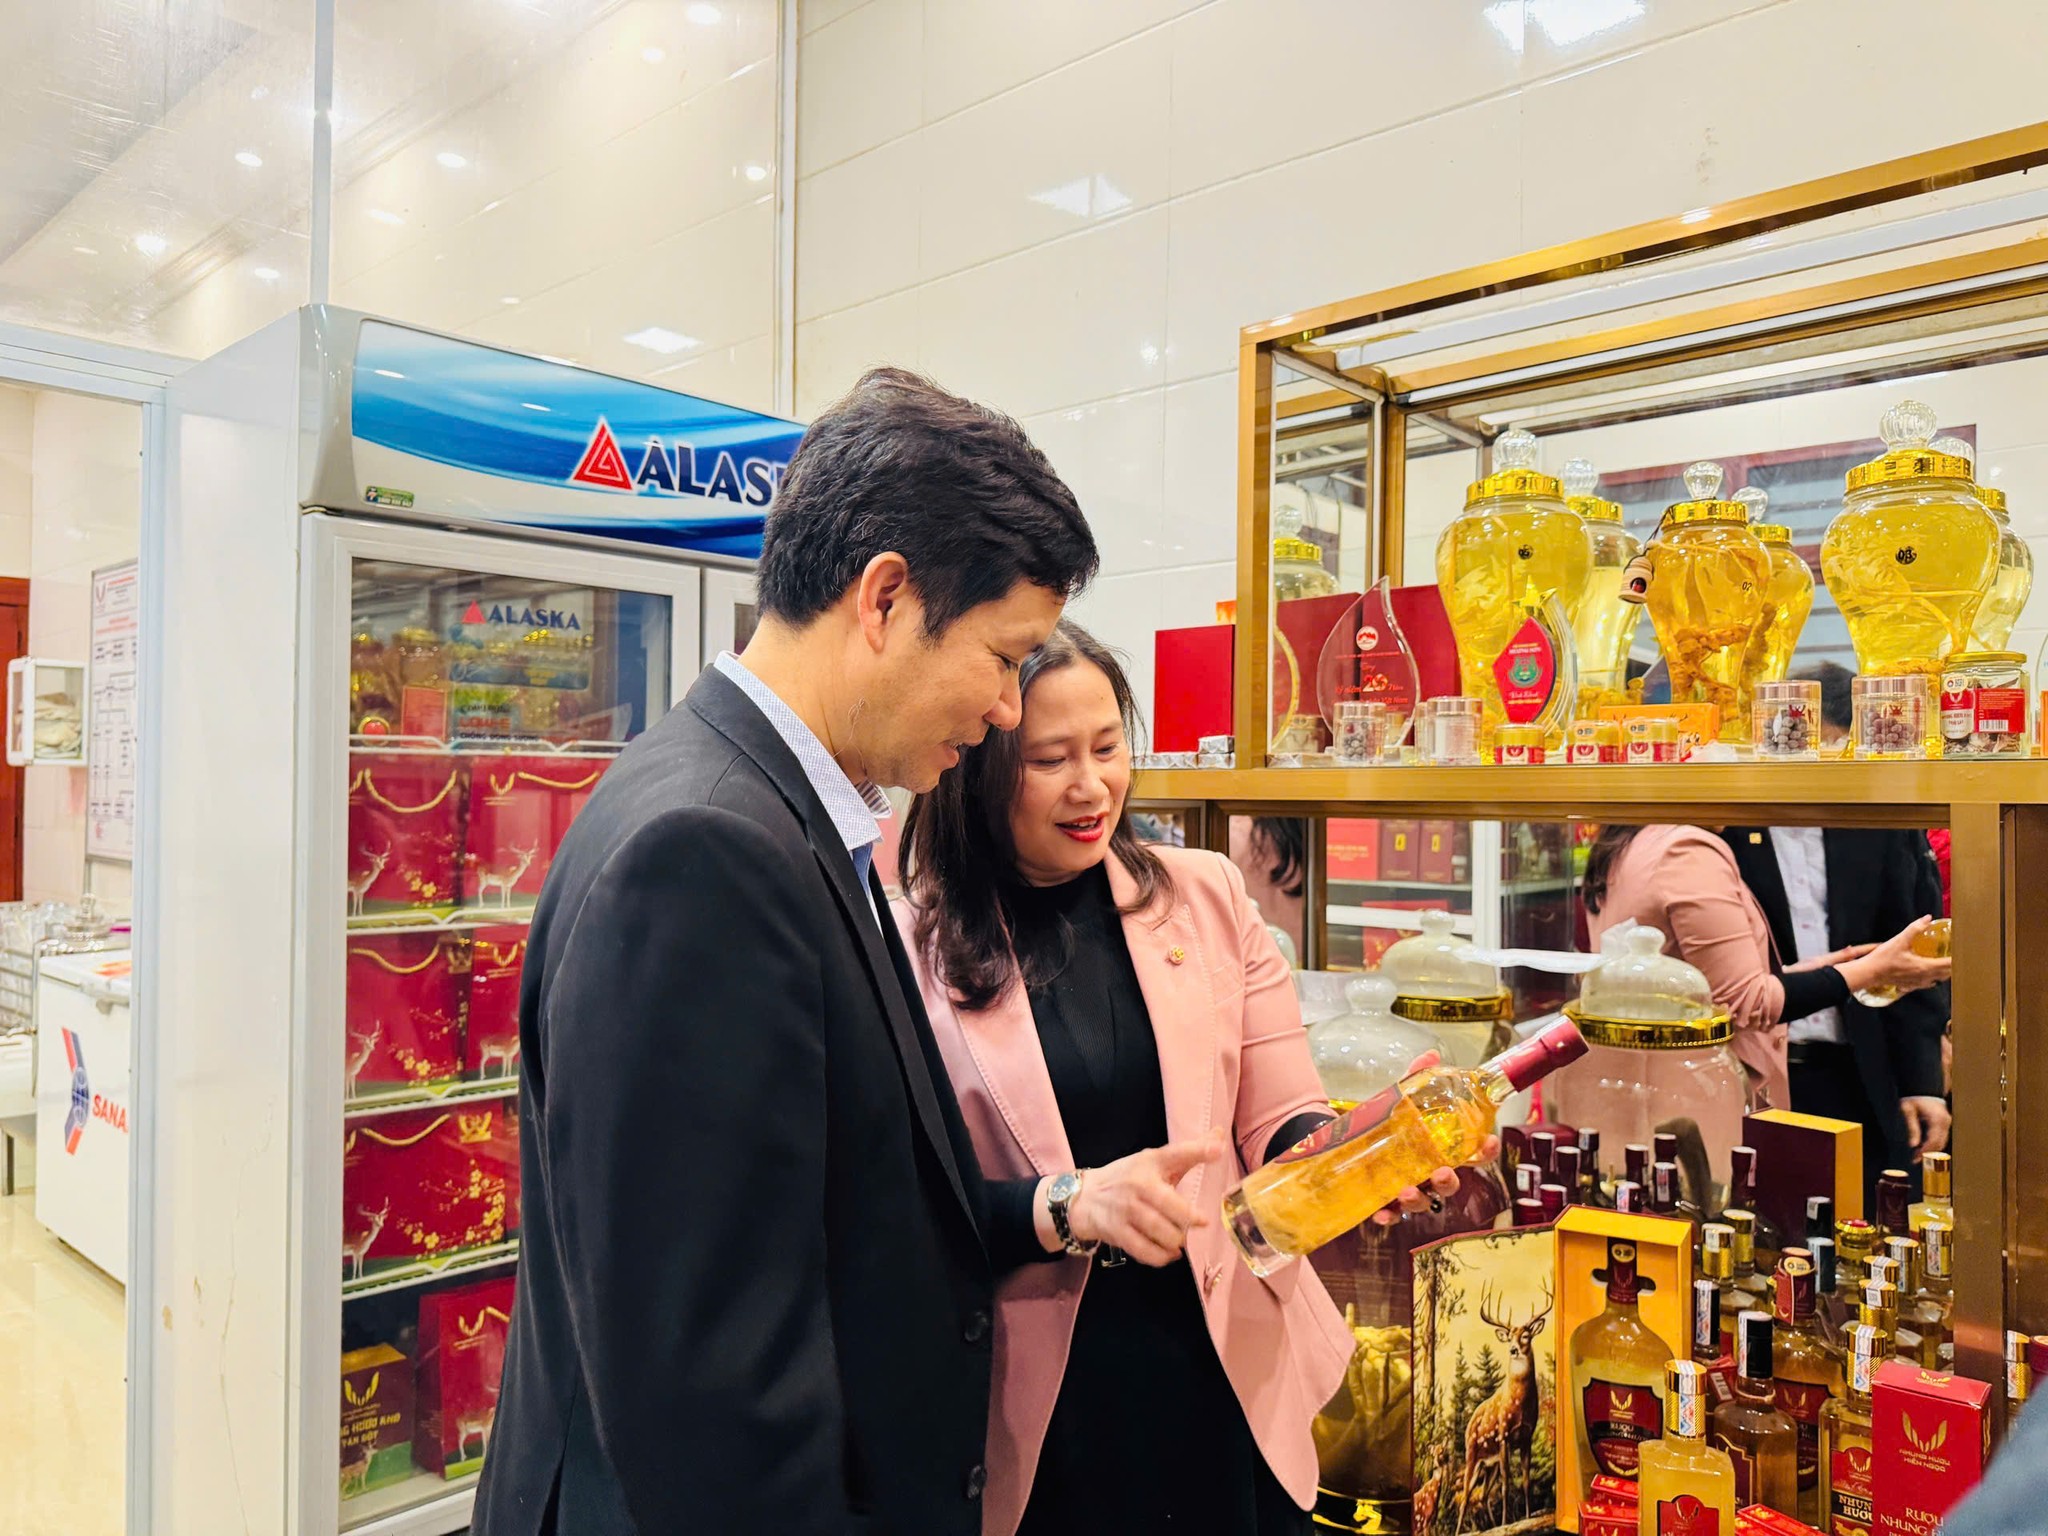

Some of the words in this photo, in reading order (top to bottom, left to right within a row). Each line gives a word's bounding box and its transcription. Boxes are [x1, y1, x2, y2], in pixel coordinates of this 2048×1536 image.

[487, 603, 581, 631] ALASKA
[92, 1093, 129, 1133] SANA
[1838, 1494, 1873, 1510] NHUN
[1880, 1513, 1928, 1536] NHUNG
